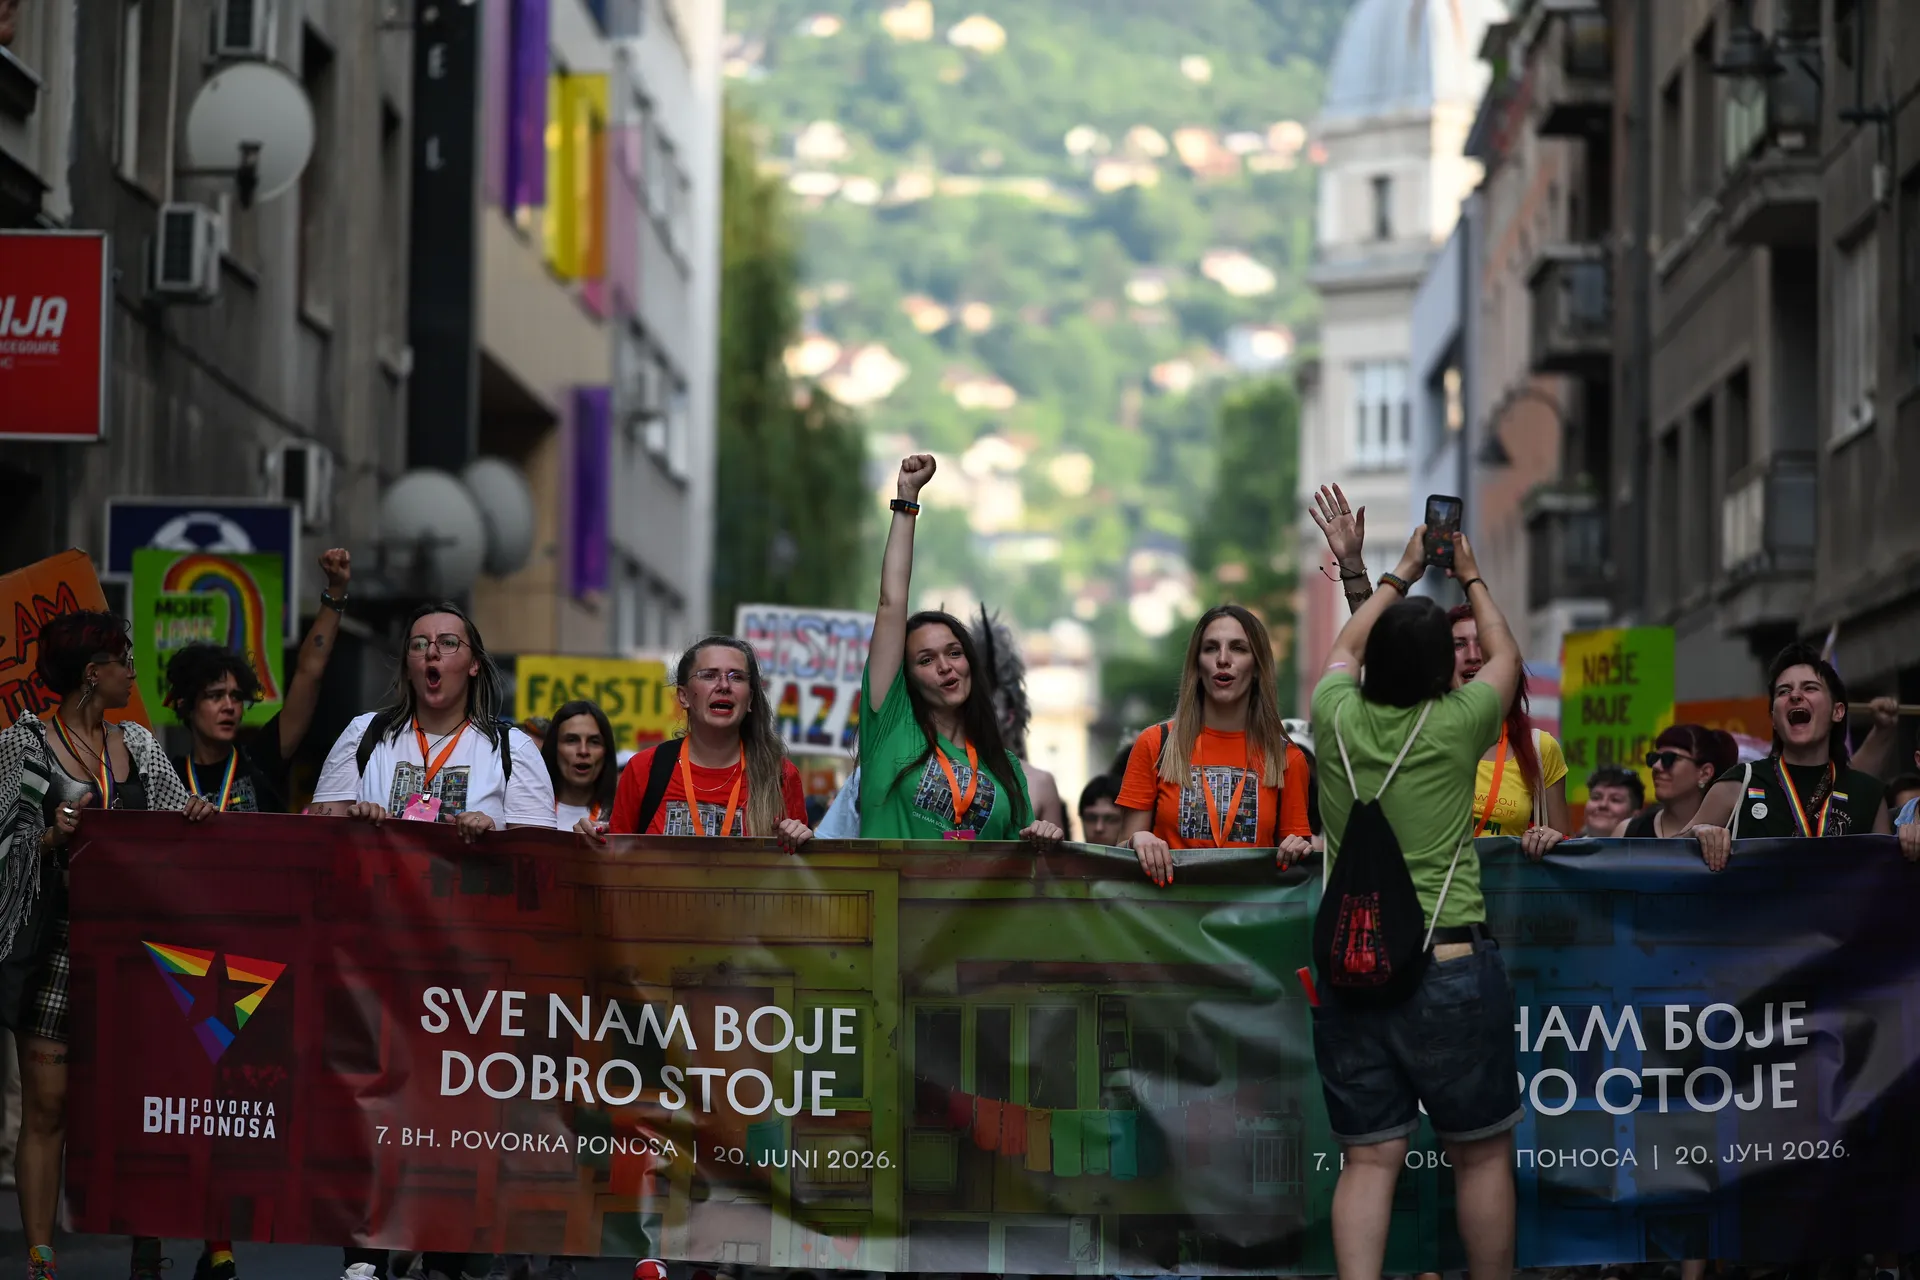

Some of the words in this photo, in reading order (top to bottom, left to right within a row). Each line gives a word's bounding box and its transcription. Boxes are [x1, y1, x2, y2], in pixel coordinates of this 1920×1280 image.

[0, 295, 68, 337] IJA
[0, 580, 80, 672] AM
[154, 598, 214, 618] MORE
[1581, 642, 1639, 686] NAŠE
[527, 673, 664, 717] FAŠISTI
[761, 681, 861, 748] AZA
[420, 986, 526, 1037] SVE
[543, 992, 698, 1051] NAM
[714, 1005, 857, 1055] BOJE
[1664, 1002, 1808, 1051] БОЈЕ
[440, 1050, 643, 1106] DOBRO
[659, 1065, 837, 1117] STOJE
[1595, 1062, 1798, 1116] СТОЈЕ
[143, 1096, 186, 1135] BH
[190, 1098, 276, 1117] POVORKA
[190, 1115, 276, 1139] PONOSA
[375, 1125, 391, 1146] 7.
[401, 1127, 441, 1148] BH.
[451, 1129, 569, 1154] POVORKA
[577, 1135, 679, 1157] PONOSA
[713, 1146, 750, 1168] 20.
[757, 1148, 818, 1169] JUNI
[827, 1149, 896, 1170] 2026.
[1313, 1152, 1330, 1171] 7.
[1516, 1147, 1639, 1168] ПОНОСА
[1675, 1145, 1714, 1166] 20.
[1722, 1142, 1773, 1163] ЈУН
[1782, 1139, 1851, 1160] 2026.
